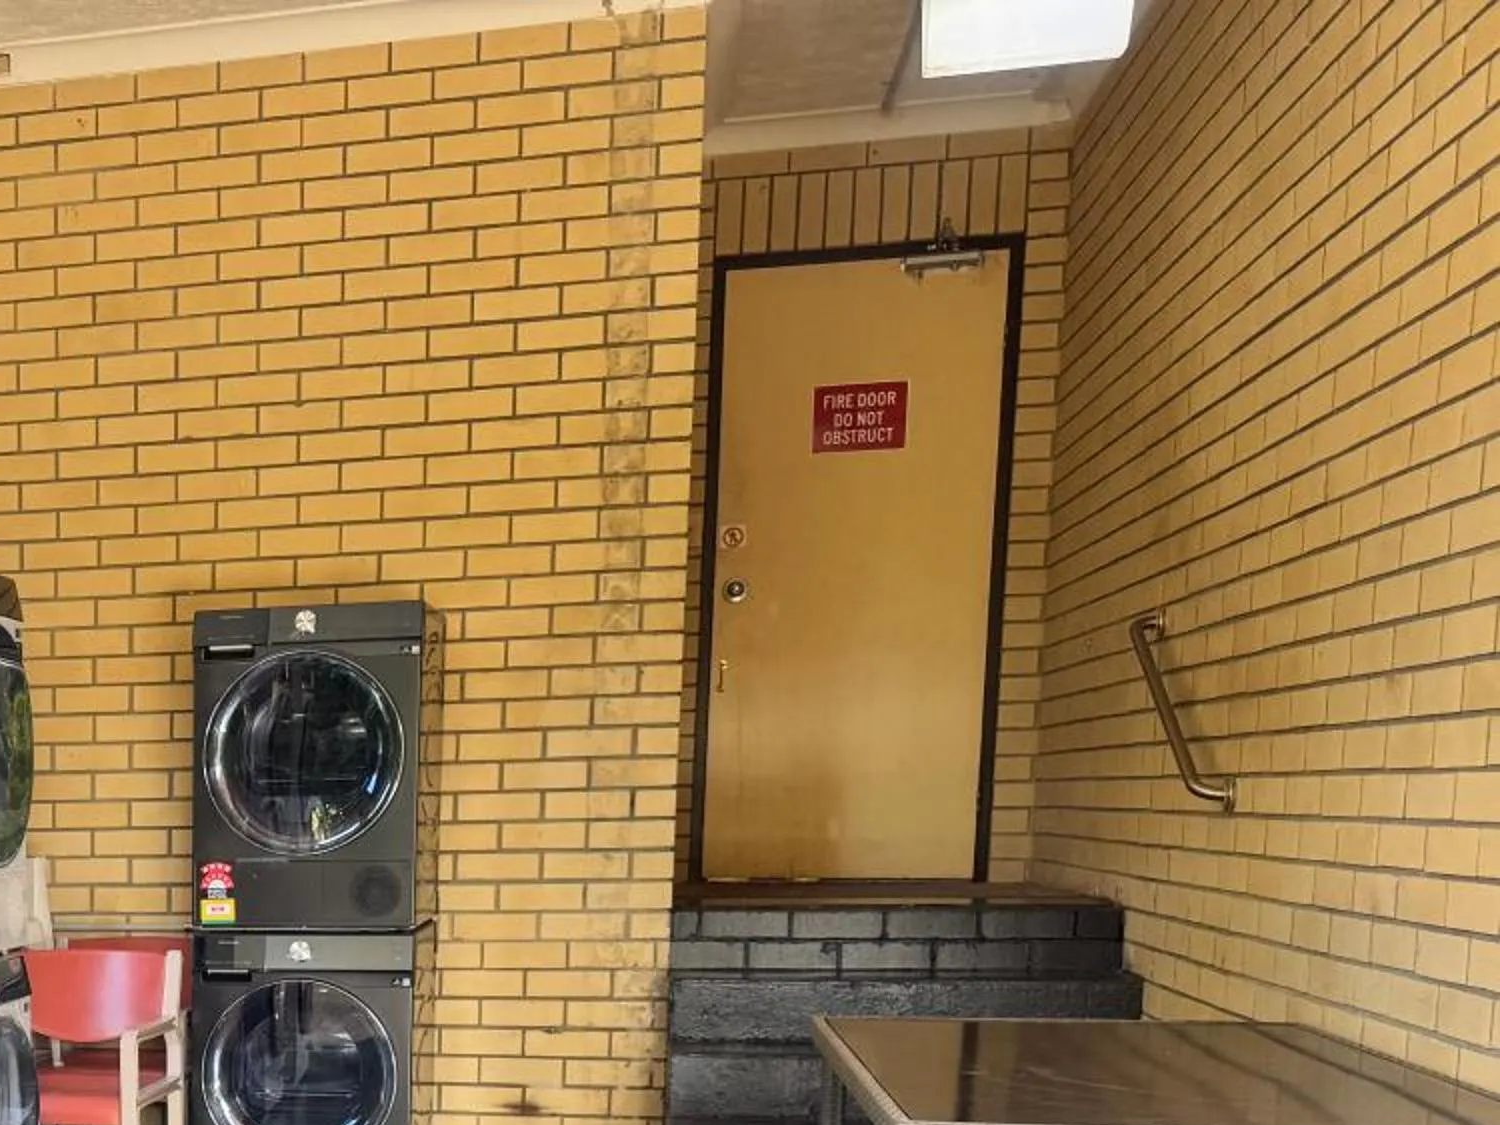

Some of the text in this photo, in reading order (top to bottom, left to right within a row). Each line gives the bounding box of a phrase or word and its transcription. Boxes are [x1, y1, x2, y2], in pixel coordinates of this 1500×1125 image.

[823, 391, 897, 410] FIRE DOOR
[834, 411, 884, 427] DO NOT
[823, 427, 894, 445] OBSTRUCT
